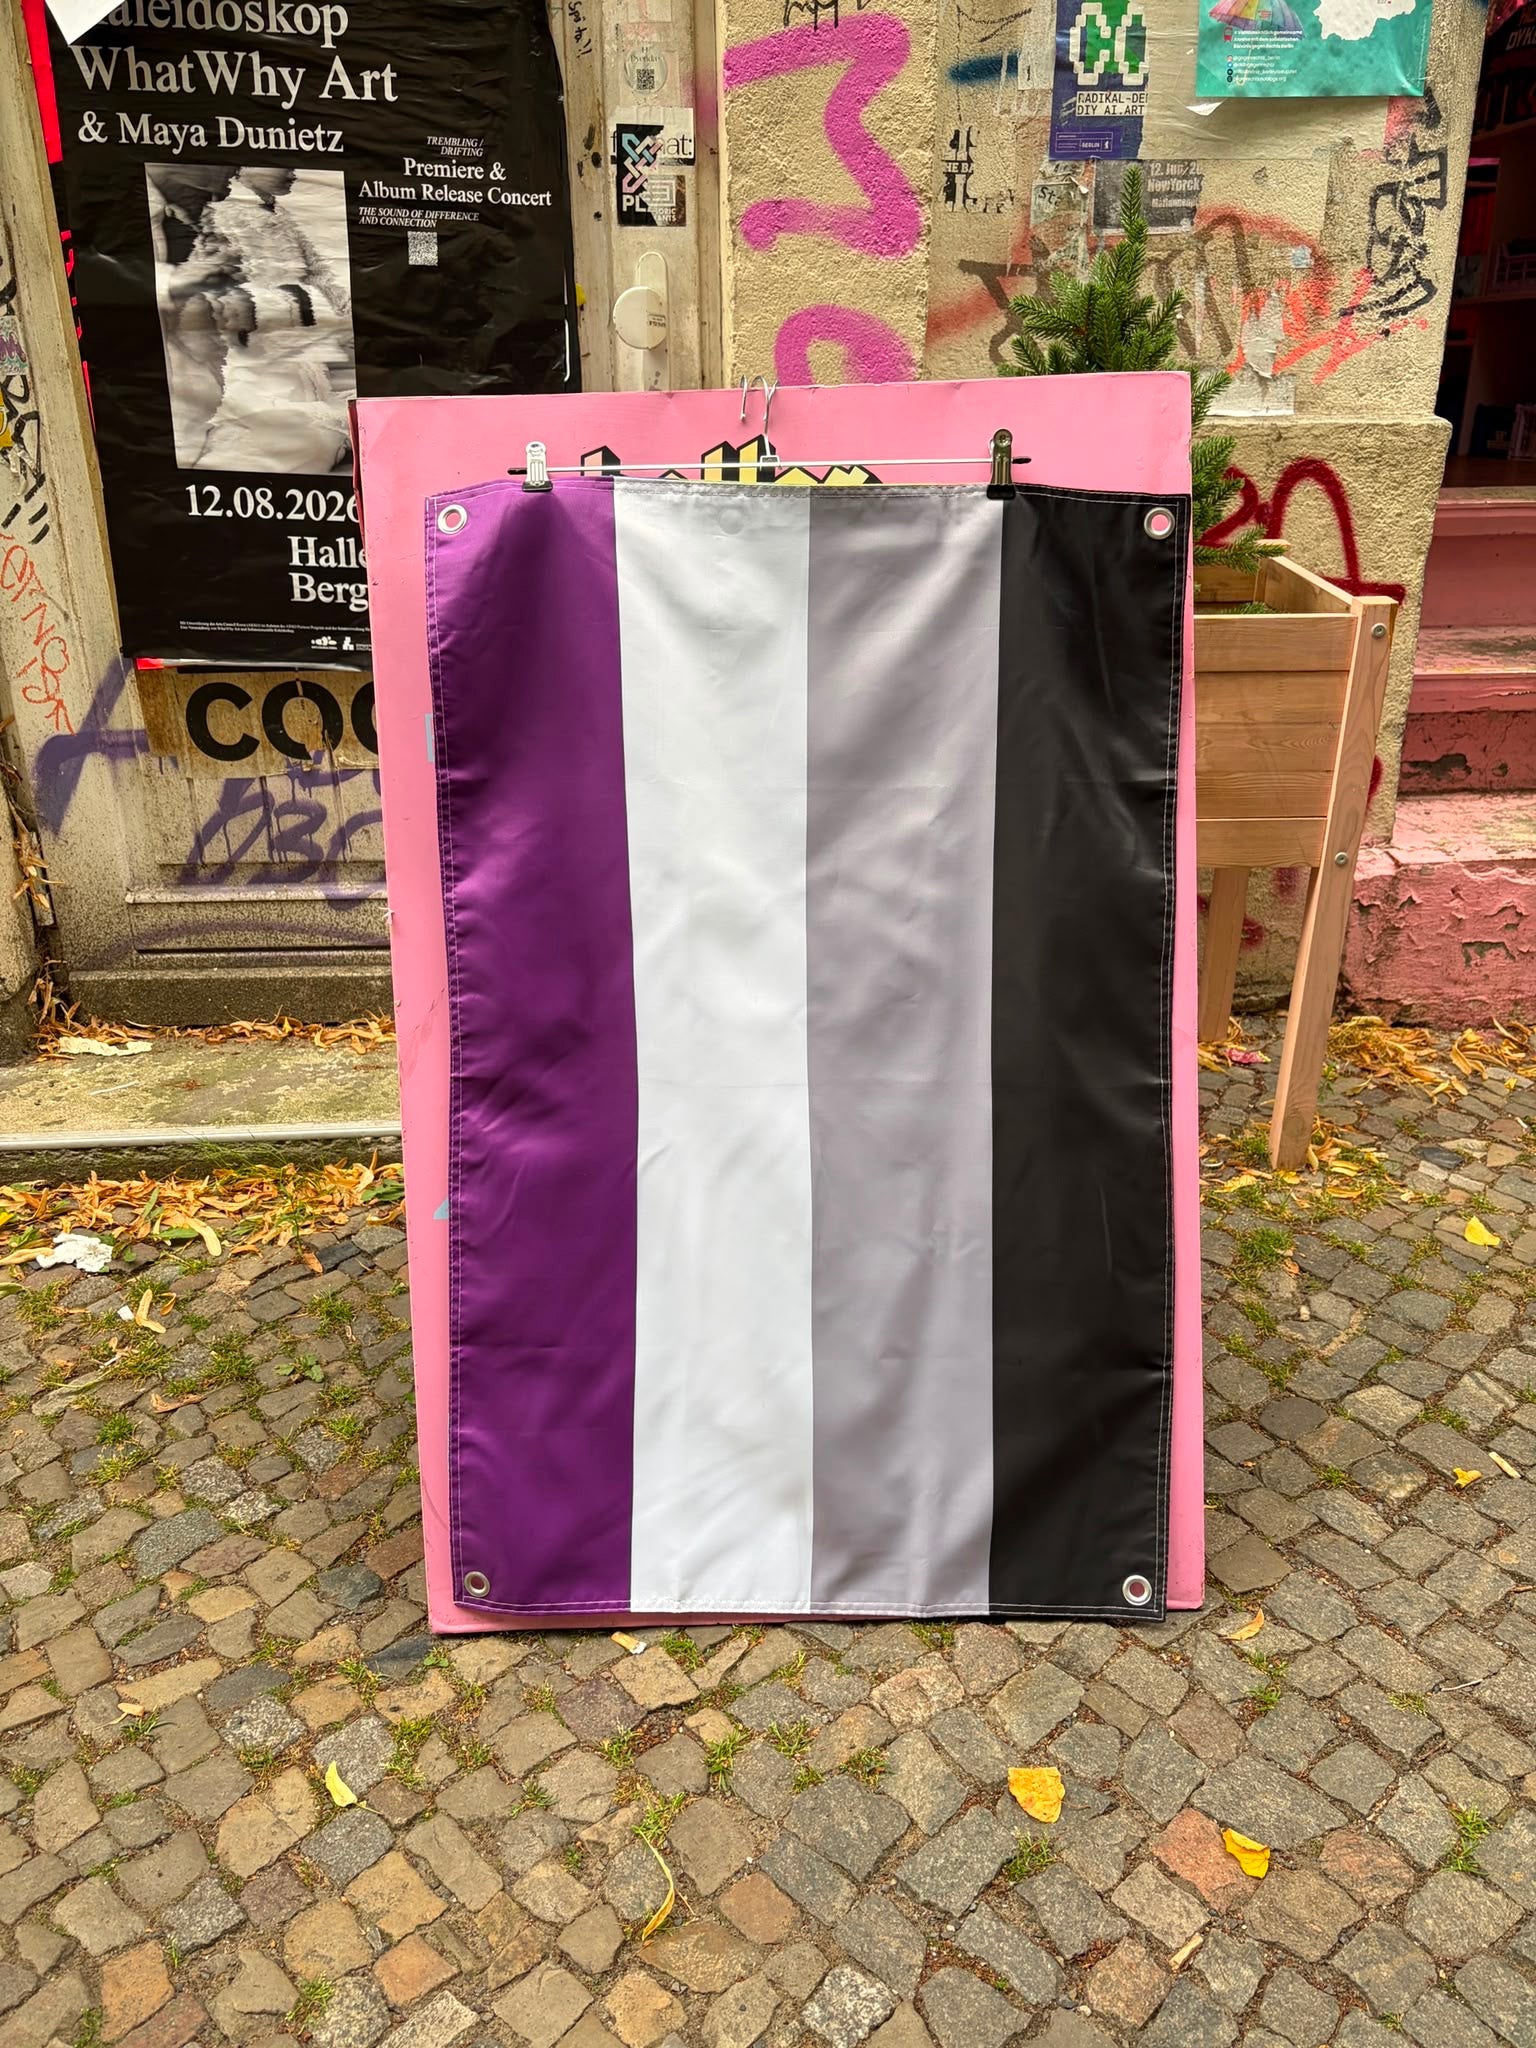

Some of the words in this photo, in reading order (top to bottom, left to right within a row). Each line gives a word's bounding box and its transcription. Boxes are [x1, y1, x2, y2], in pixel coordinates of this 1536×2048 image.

[1504, 25, 1536, 51] DYK
[318, 55, 399, 102] Art
[1077, 105, 1097, 115] DIY
[1104, 105, 1144, 115] AI.ART
[78, 111, 108, 143] &
[116, 112, 208, 155] Maya
[215, 116, 344, 153] Dunietz
[426, 136, 478, 147] TREMBLING
[440, 147, 483, 157] DRIFTING
[402, 157, 484, 179] Premiere
[489, 161, 507, 181] &
[358, 180, 417, 200] Album
[421, 184, 483, 203] Release
[487, 187, 552, 206] Concert
[359, 207, 376, 216] THE
[378, 208, 409, 218] SOUND
[411, 210, 423, 218] OF
[425, 211, 479, 221] DIFFERENCE
[359, 216, 378, 225] AND
[380, 217, 437, 228] CONNECTION
[288, 572, 369, 612] Berg
